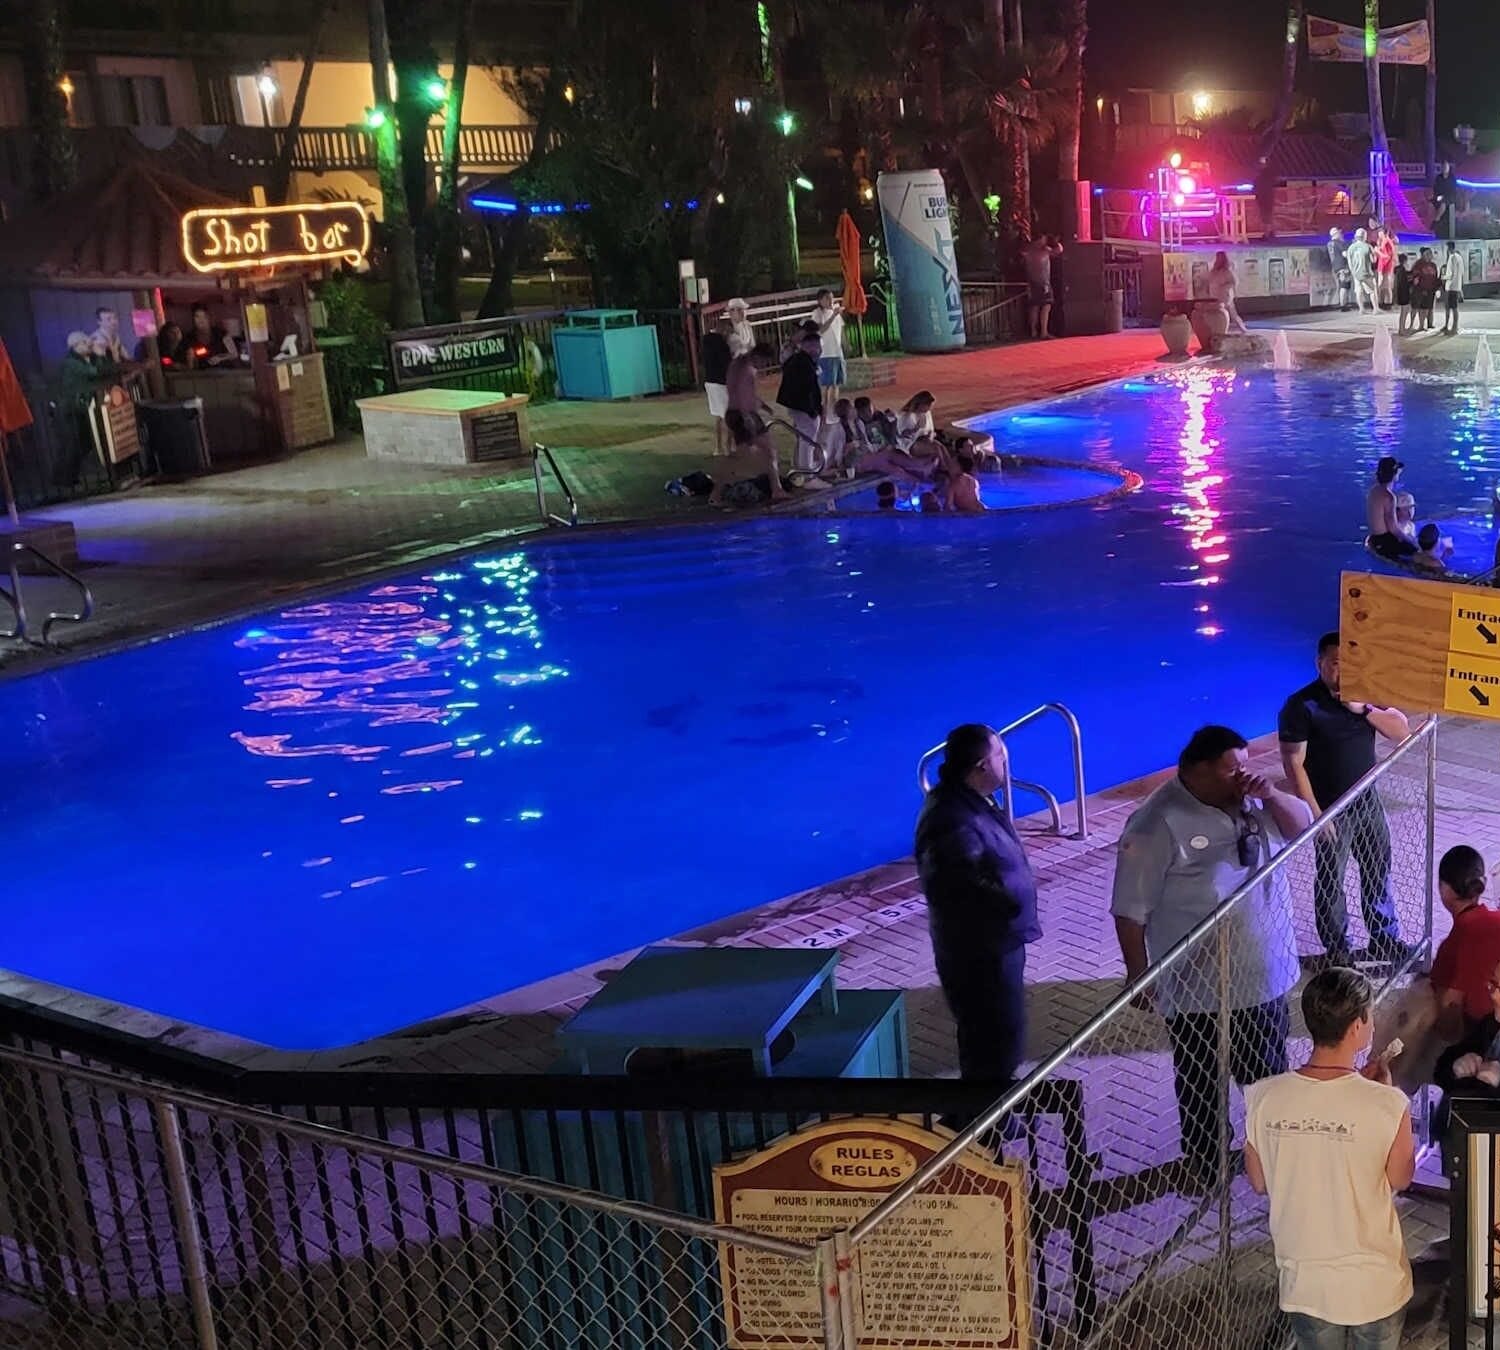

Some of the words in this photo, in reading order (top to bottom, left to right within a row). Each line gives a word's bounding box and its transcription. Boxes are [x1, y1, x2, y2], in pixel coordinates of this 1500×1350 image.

[924, 207, 948, 219] LIG
[203, 217, 271, 256] Shot
[298, 213, 350, 252] bar
[438, 336, 506, 361] WESTERN
[837, 1147, 894, 1160] RULES
[831, 1164, 901, 1178] REGLAS
[774, 1196, 807, 1206] HOURS
[815, 1197, 858, 1208] HORARIO
